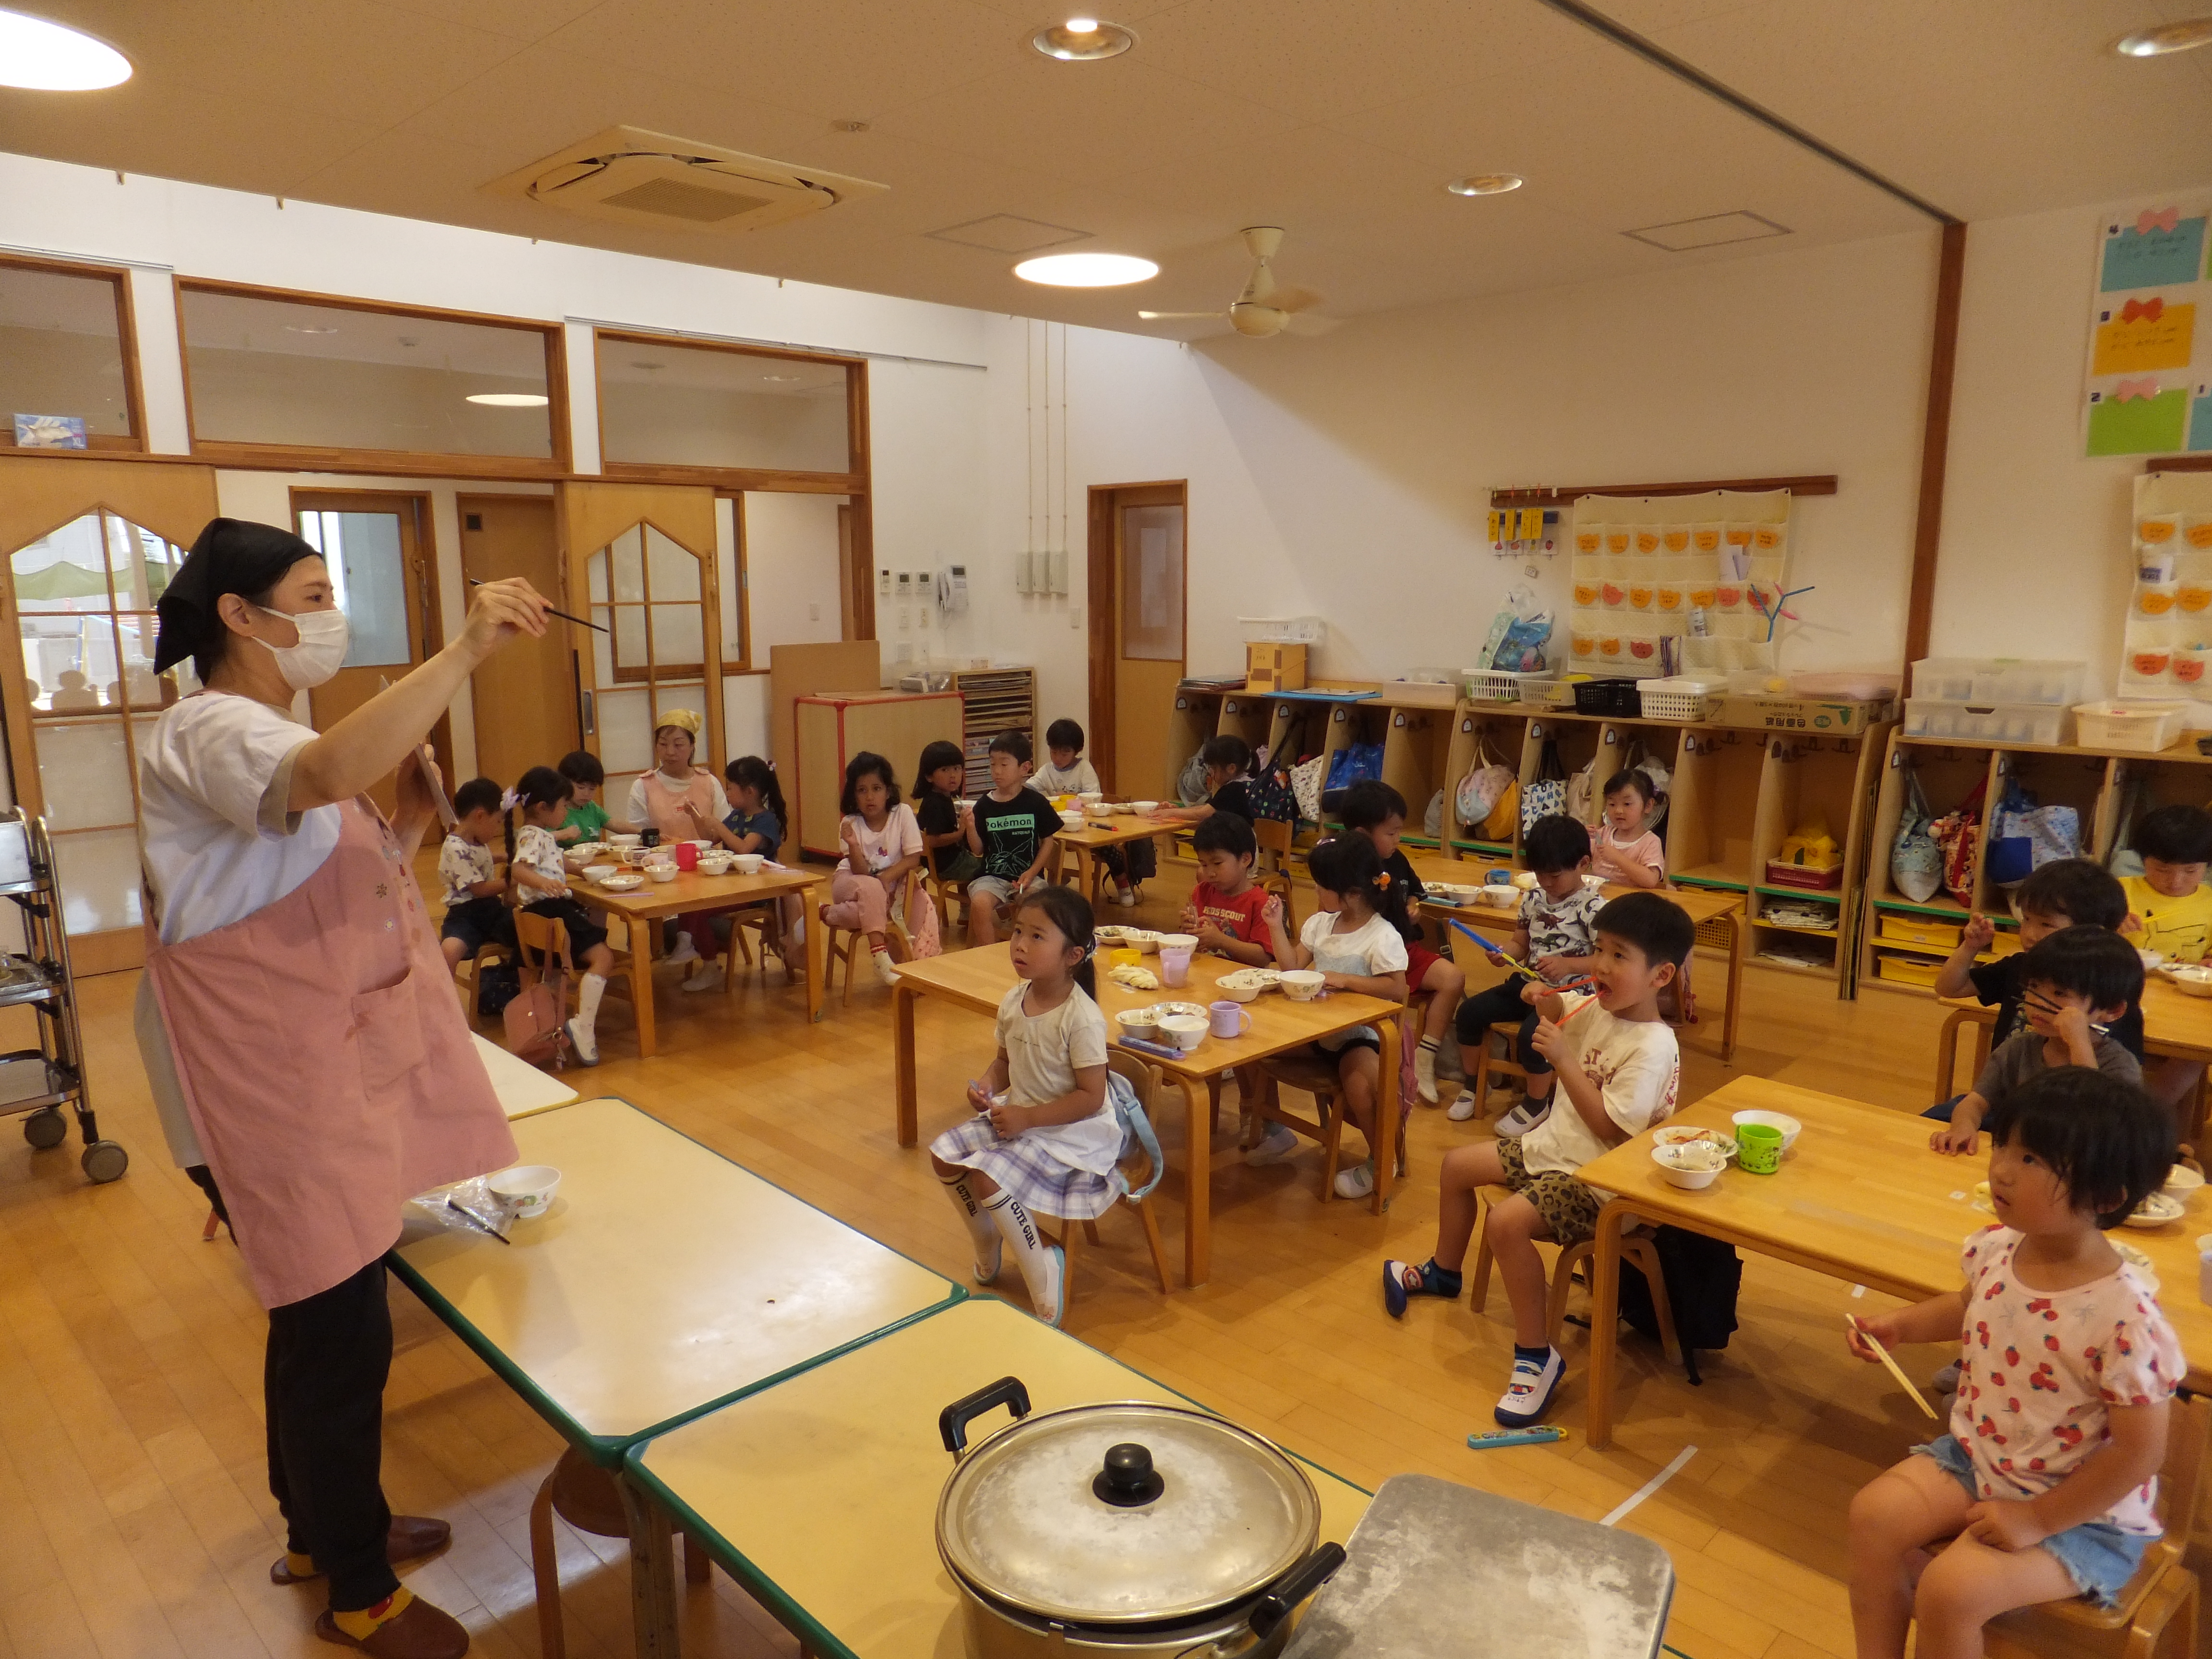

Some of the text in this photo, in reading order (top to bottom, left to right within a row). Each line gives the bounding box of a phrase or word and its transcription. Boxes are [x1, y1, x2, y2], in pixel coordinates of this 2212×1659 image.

[1765, 717, 1806, 728] 色画用紙
[1220, 909, 1246, 922] SCOUT
[956, 1184, 978, 1217] CUTE GIRL
[1010, 1201, 1036, 1250] CUTE GIRL
